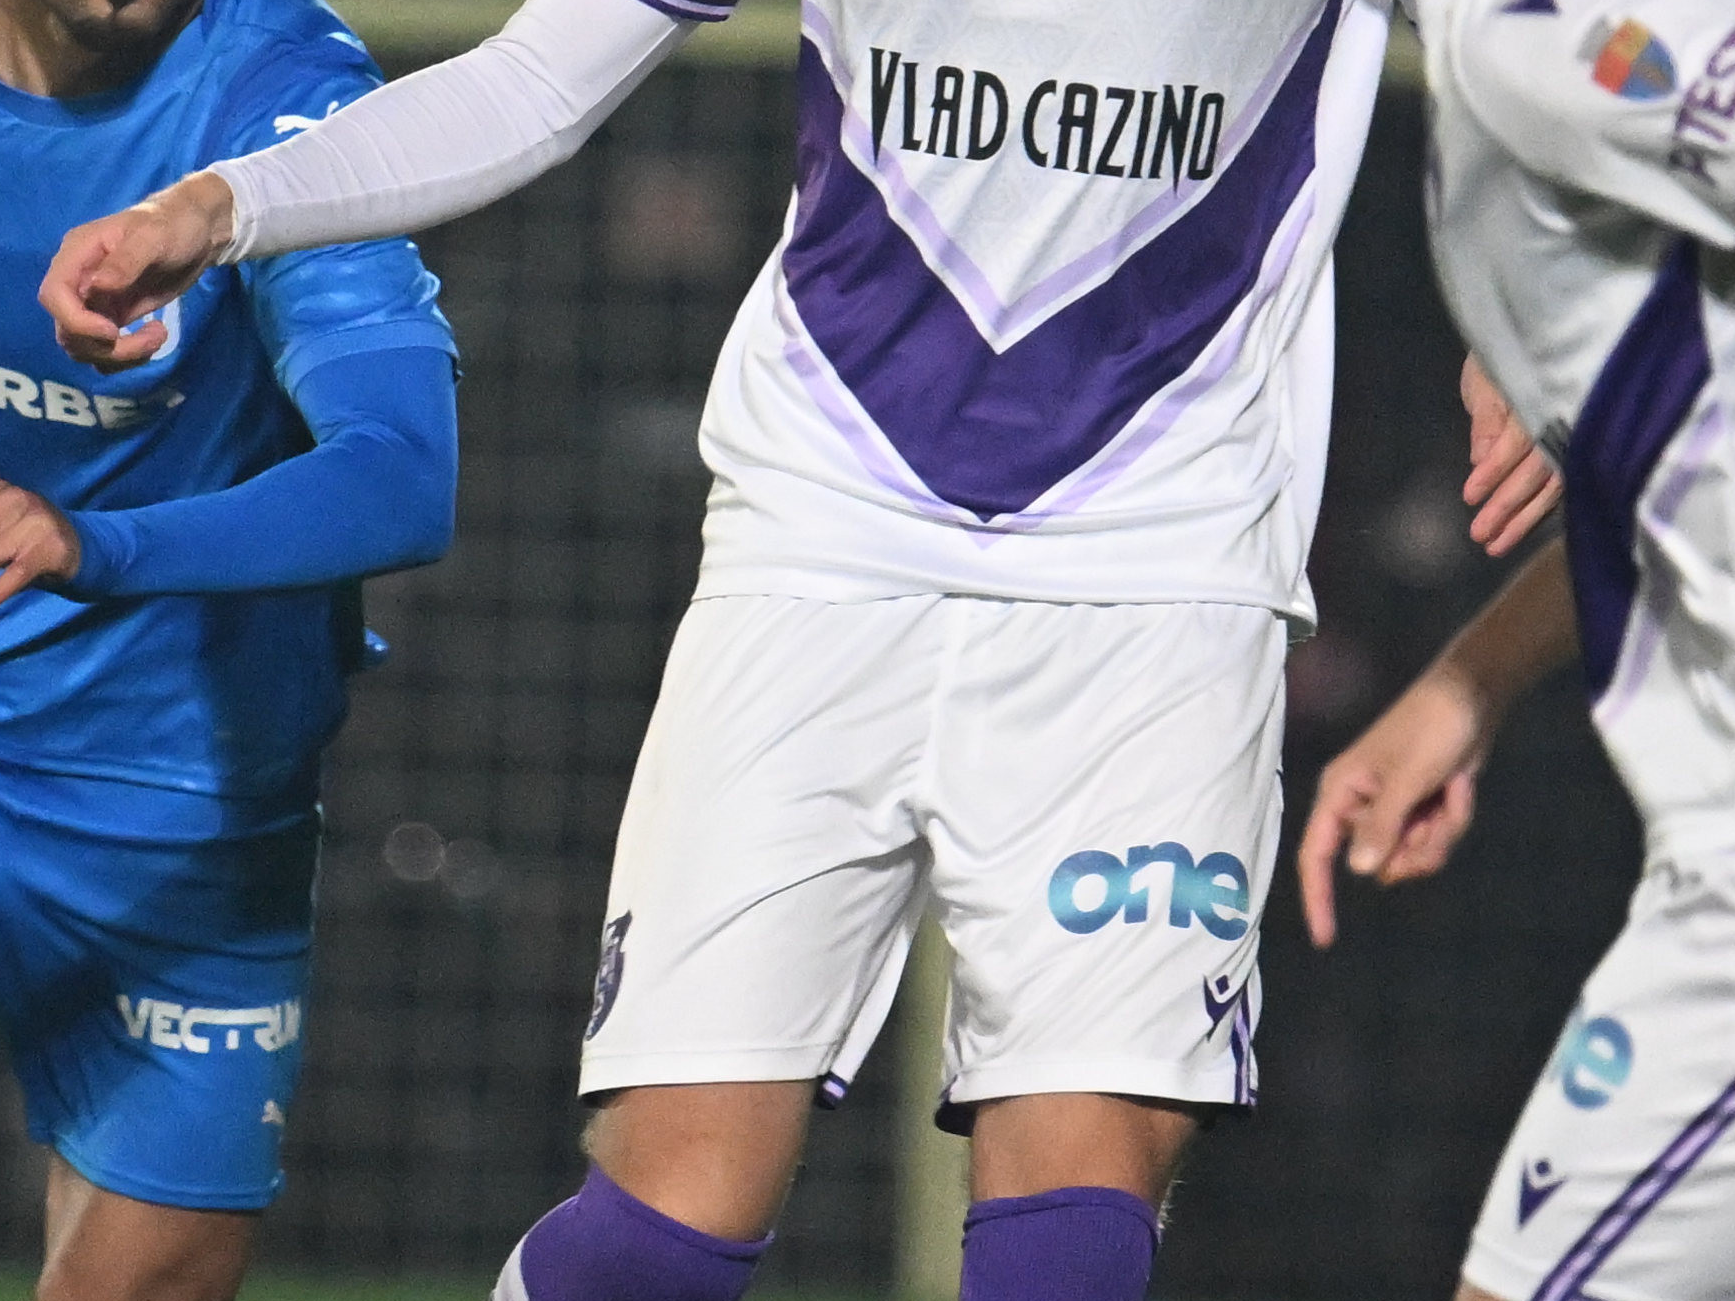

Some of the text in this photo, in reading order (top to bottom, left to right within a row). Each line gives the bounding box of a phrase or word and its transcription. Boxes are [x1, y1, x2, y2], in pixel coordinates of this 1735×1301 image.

[870, 48, 1226, 196] VLAD CAZINO
[1048, 840, 1250, 941] one
